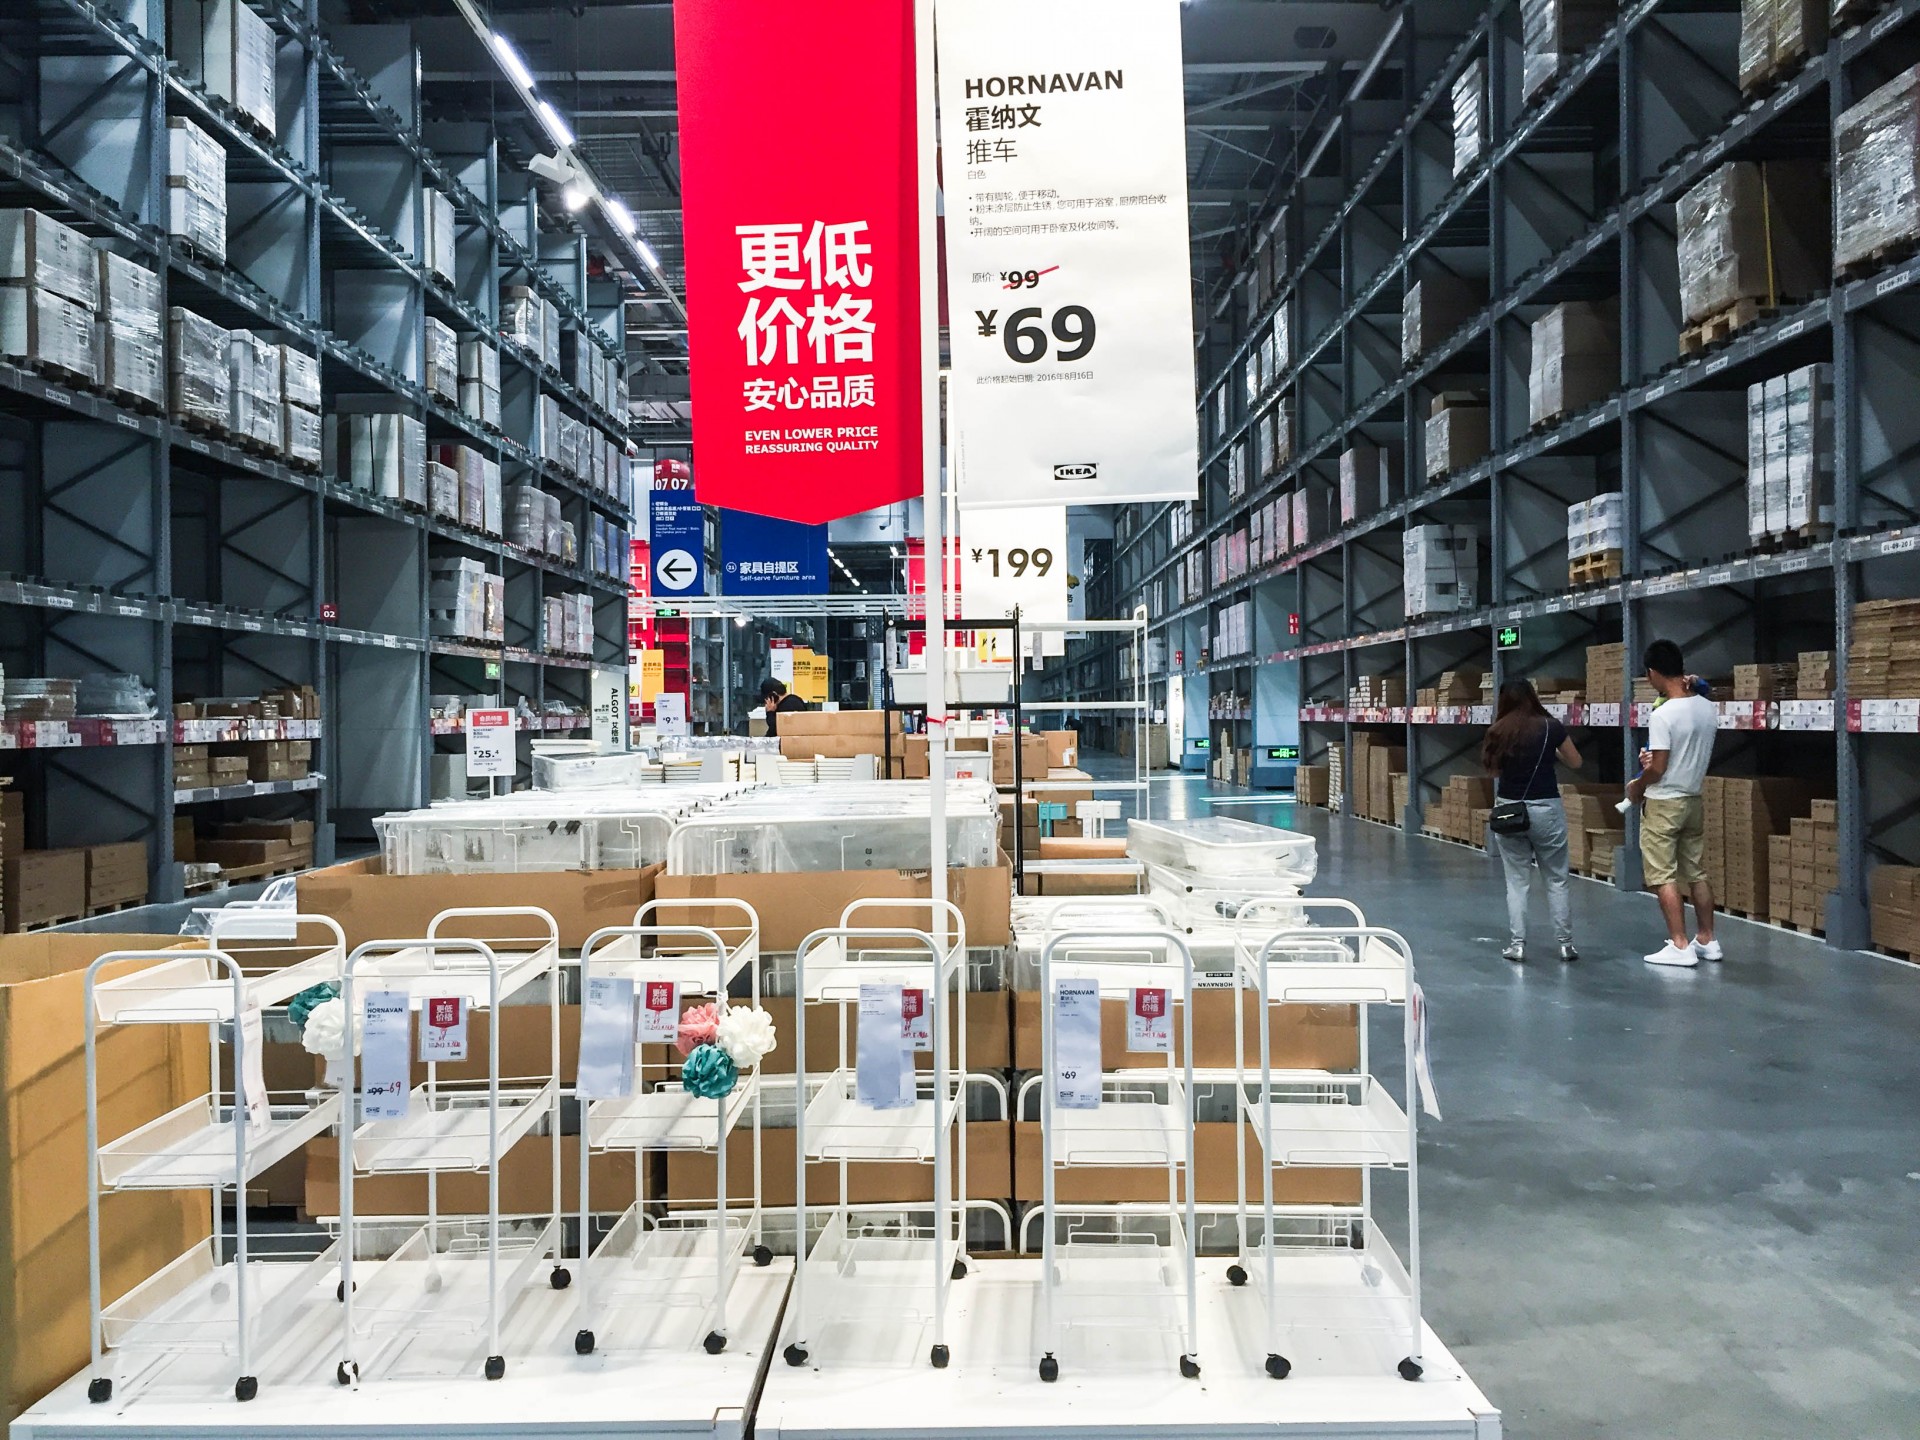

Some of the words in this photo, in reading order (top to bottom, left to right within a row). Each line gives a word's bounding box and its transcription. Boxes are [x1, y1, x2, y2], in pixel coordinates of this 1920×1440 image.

[965, 69, 1123, 98] HORNAVAN
[965, 102, 1042, 132] 霍纳文
[966, 137, 1018, 165] 推车
[735, 219, 874, 294] 更低
[999, 270, 1040, 290] ¥99
[737, 292, 877, 367] 价格
[974, 304, 1097, 364] ¥69
[743, 373, 876, 412] 安心品质
[745, 429, 781, 442] EVEN
[784, 427, 833, 440] LOWER
[837, 425, 878, 438] PRICE
[745, 441, 823, 455] REASSURING
[826, 440, 879, 454] QUALITY
[655, 477, 668, 490] 07
[671, 477, 688, 490] 07
[739, 561, 799, 575] 家具自提区
[971, 547, 1053, 578] ¥199
[323, 610, 336, 618] 02
[611, 687, 619, 720] ALGOT
